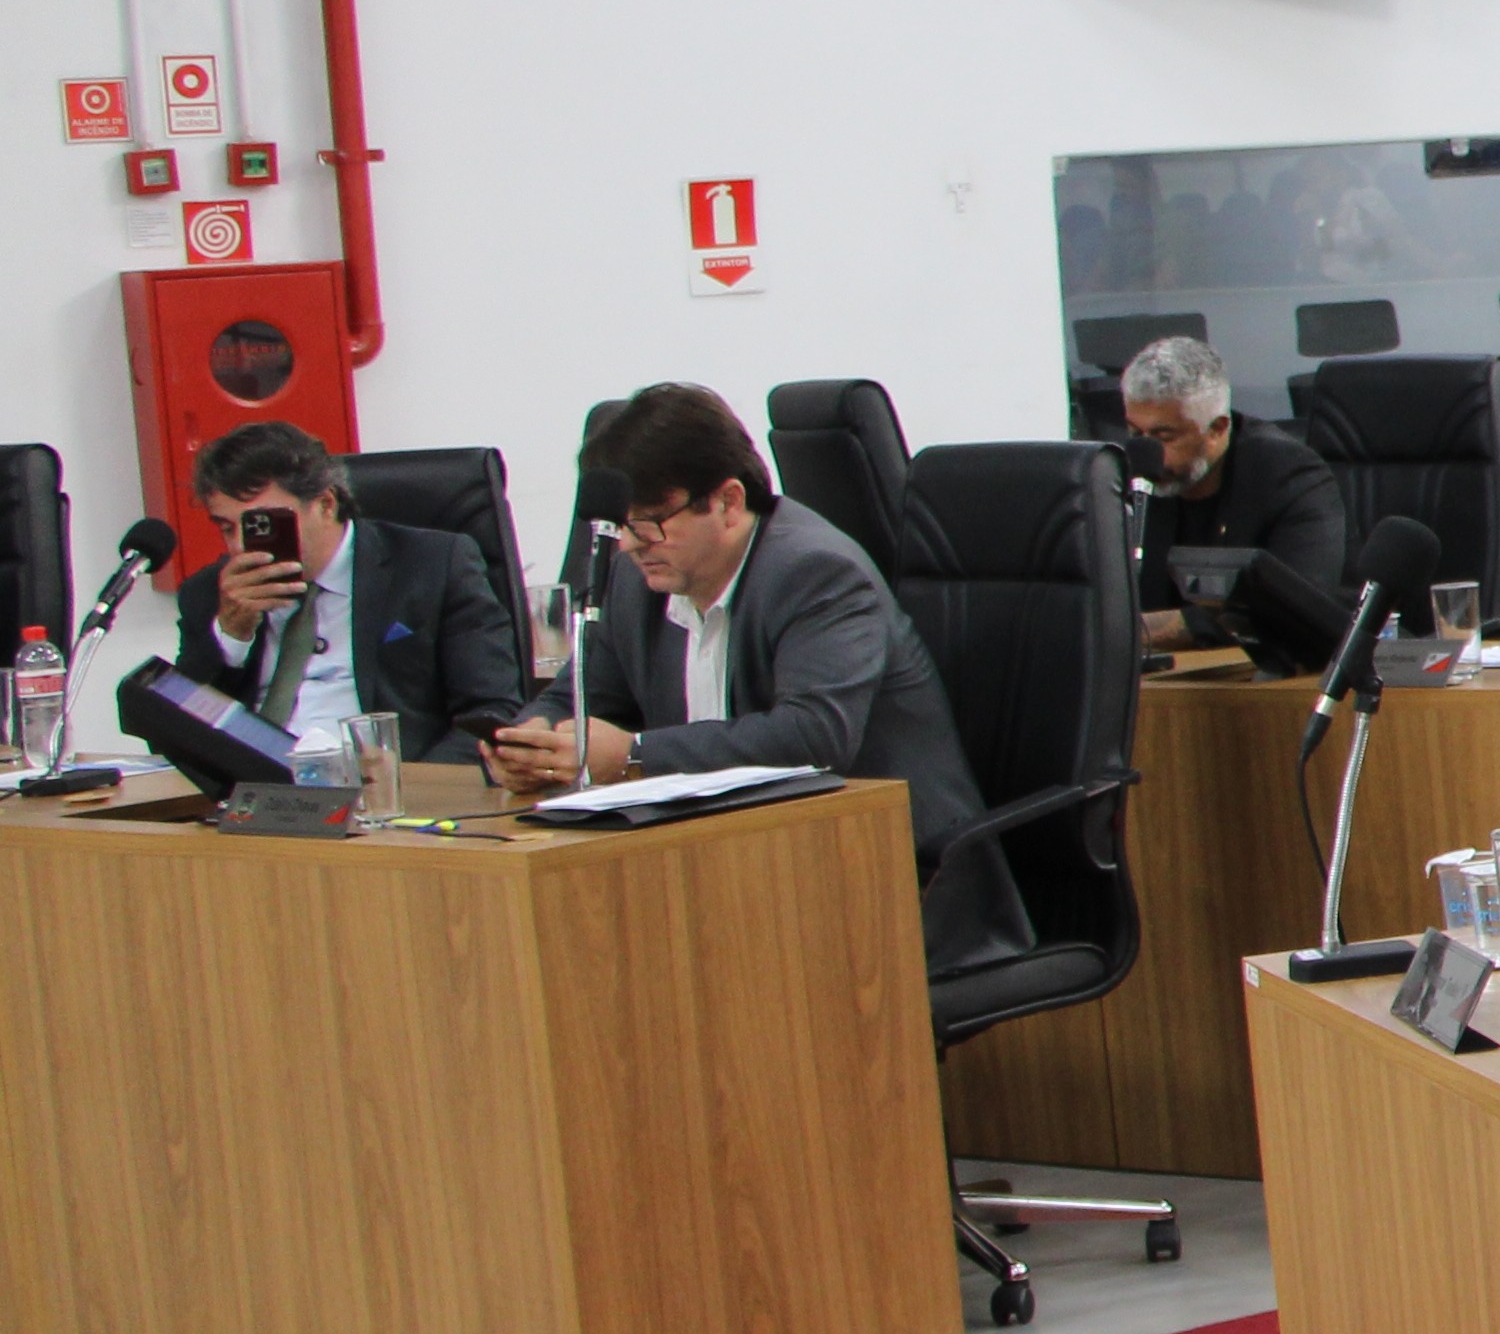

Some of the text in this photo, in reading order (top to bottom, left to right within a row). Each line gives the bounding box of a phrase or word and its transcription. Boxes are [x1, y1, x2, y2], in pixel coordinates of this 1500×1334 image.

[72, 117, 125, 128] ALARME DE
[704, 258, 749, 268] EXTINTOR
